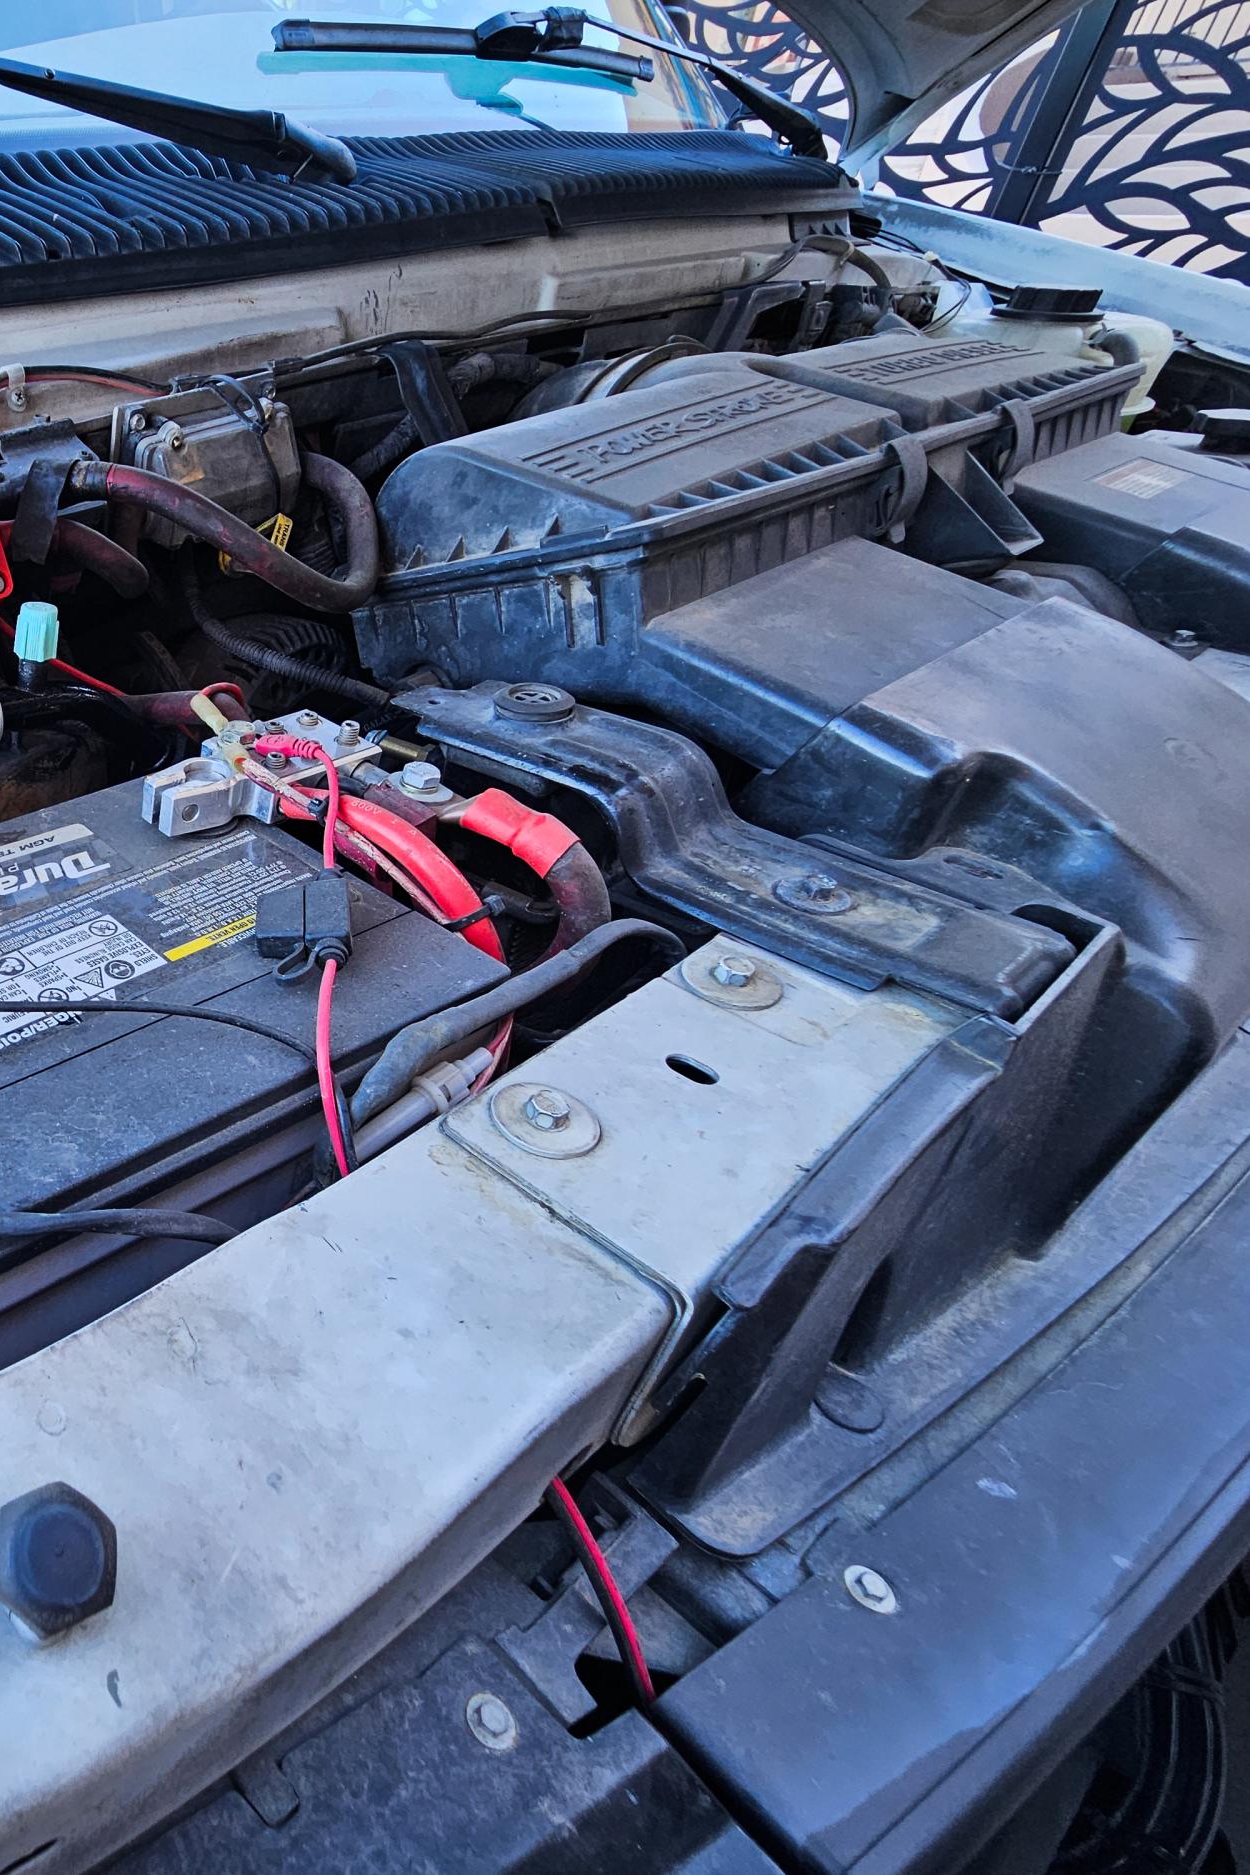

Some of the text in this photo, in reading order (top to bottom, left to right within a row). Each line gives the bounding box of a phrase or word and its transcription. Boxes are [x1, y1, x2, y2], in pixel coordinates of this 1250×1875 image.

[18, 835, 56, 851] AGM
[228, 921, 248, 932] OPEN
[63, 929, 86, 941] REACH
[76, 933, 91, 942] KEEP
[62, 939, 76, 947] OUT
[123, 936, 136, 944] CAN
[105, 941, 125, 951] CAUSE
[41, 948, 54, 956] THE
[86, 941, 143, 967] EXPLOSIVE GASES
[133, 953, 157, 966] SHIELD
[65, 984, 77, 992] NO
[7, 989, 21, 997] CAN
